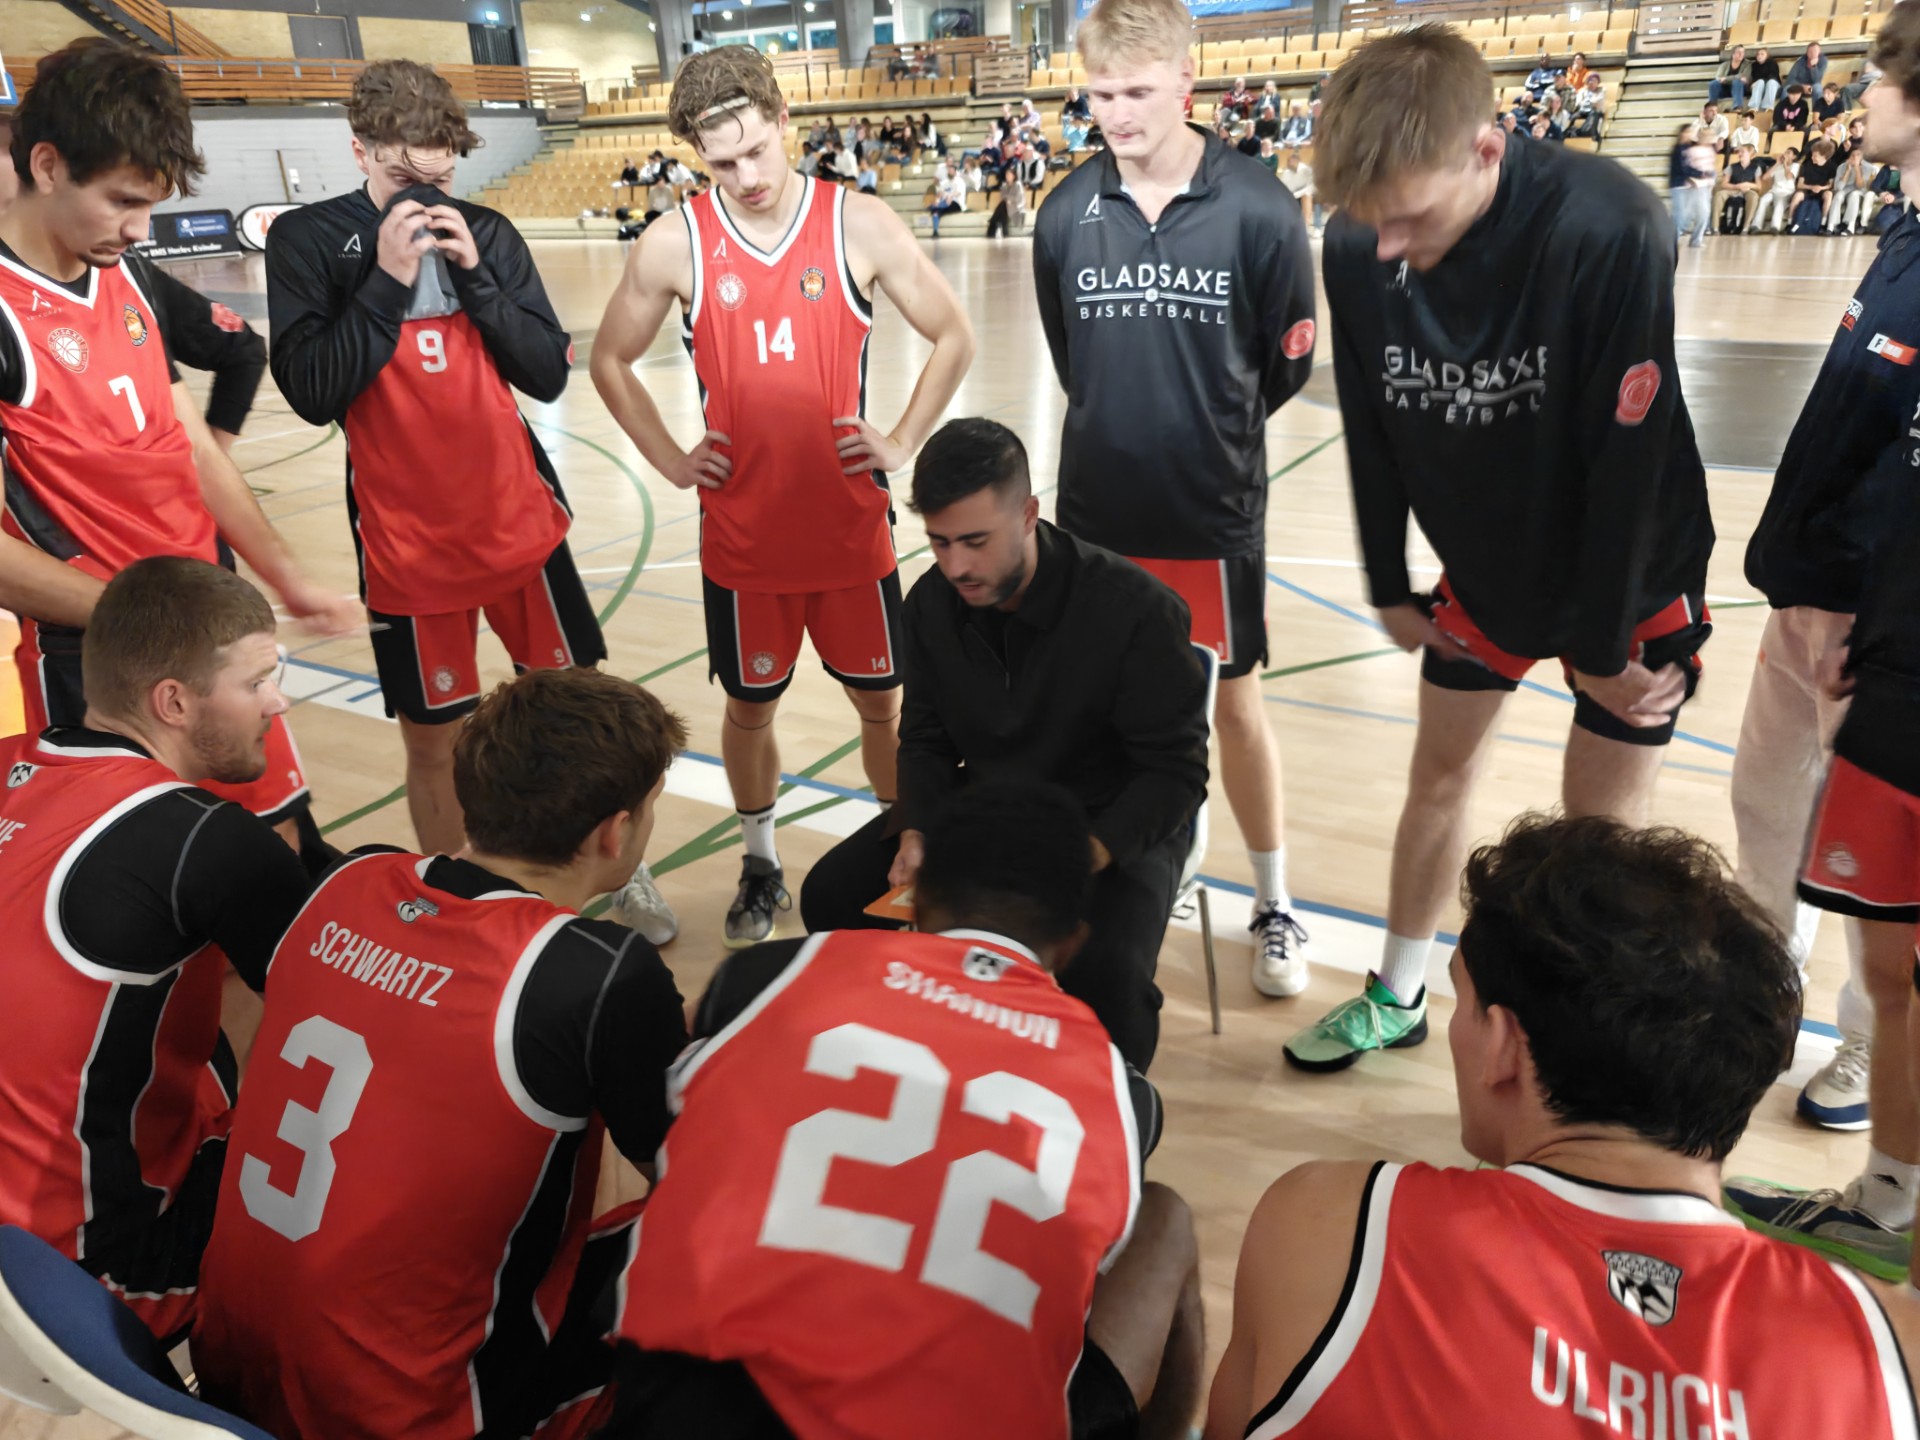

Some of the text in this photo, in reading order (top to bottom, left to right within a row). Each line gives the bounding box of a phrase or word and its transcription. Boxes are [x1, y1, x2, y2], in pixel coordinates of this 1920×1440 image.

[1077, 264, 1231, 295] GLADSAXE
[1080, 303, 1227, 324] BASKETBALL
[416, 329, 447, 374] 9
[753, 316, 796, 364] 14
[108, 375, 146, 432] 7
[553, 648, 566, 663] 9
[871, 656, 888, 671] 14
[310, 920, 454, 1007] SCHWARTZ
[882, 961, 1060, 1049] SHANNON
[238, 1014, 374, 1243] 3
[757, 1022, 1086, 1332] 22
[1530, 1324, 1750, 1440] ULRICH
